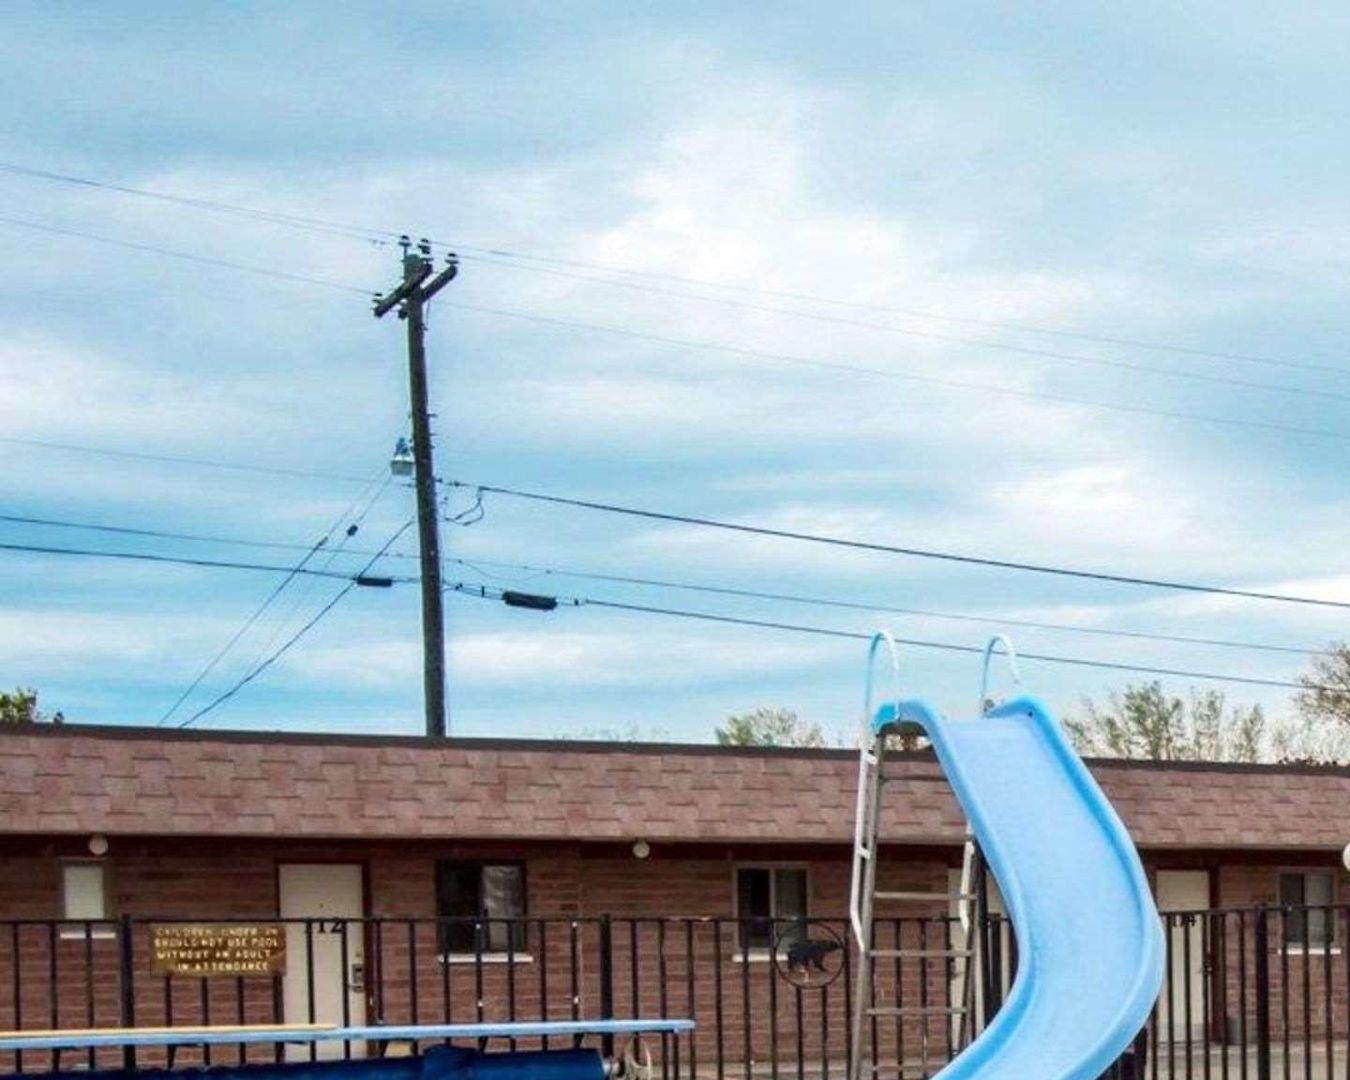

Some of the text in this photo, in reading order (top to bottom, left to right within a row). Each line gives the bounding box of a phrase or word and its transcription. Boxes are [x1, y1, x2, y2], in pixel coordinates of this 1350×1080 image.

[156, 927, 212, 937] CHILDREN
[221, 927, 257, 936] UNDER
[154, 936, 277, 948] SHOULD NOT USE POOL
[157, 948, 270, 960] WITHOUT AN ADULT
[177, 960, 268, 971] IN ATTENDANCE
